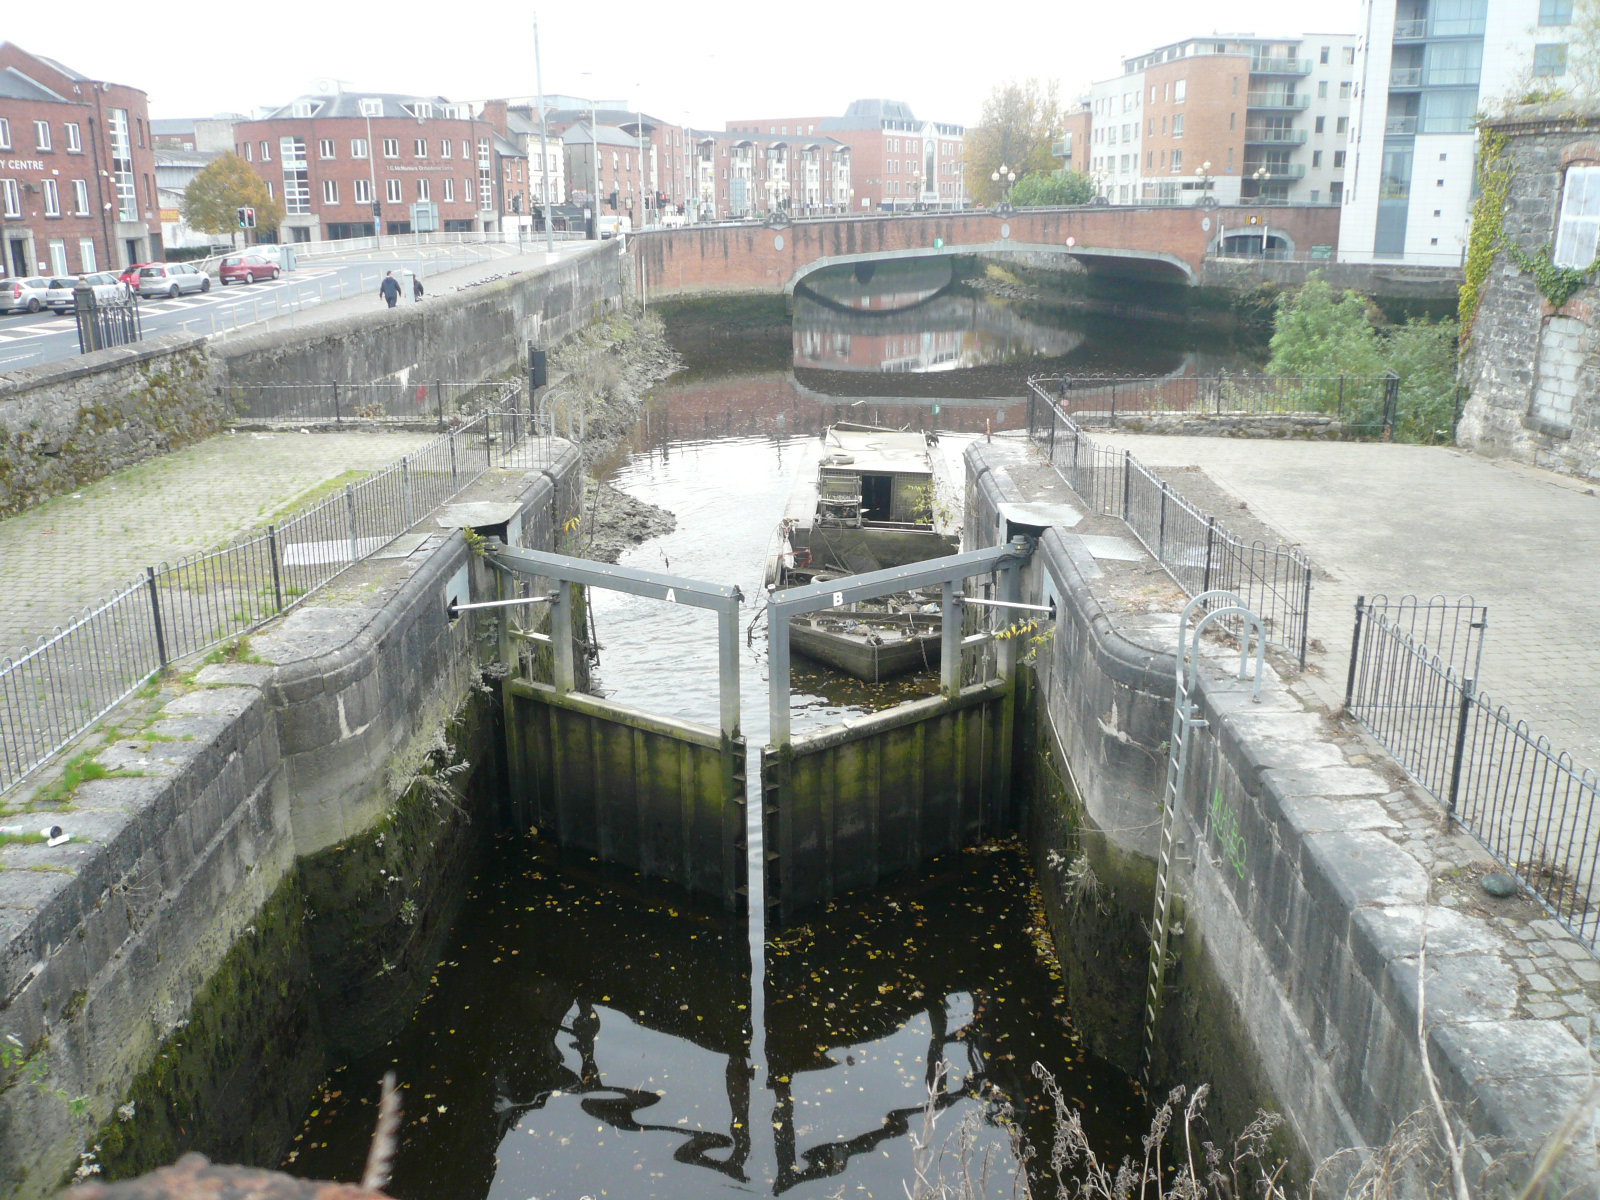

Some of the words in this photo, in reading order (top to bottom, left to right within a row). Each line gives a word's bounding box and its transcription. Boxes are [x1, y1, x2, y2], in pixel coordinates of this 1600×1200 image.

[8, 160, 44, 170] CENTRE
[665, 588, 676, 603] A
[832, 592, 844, 607] B
